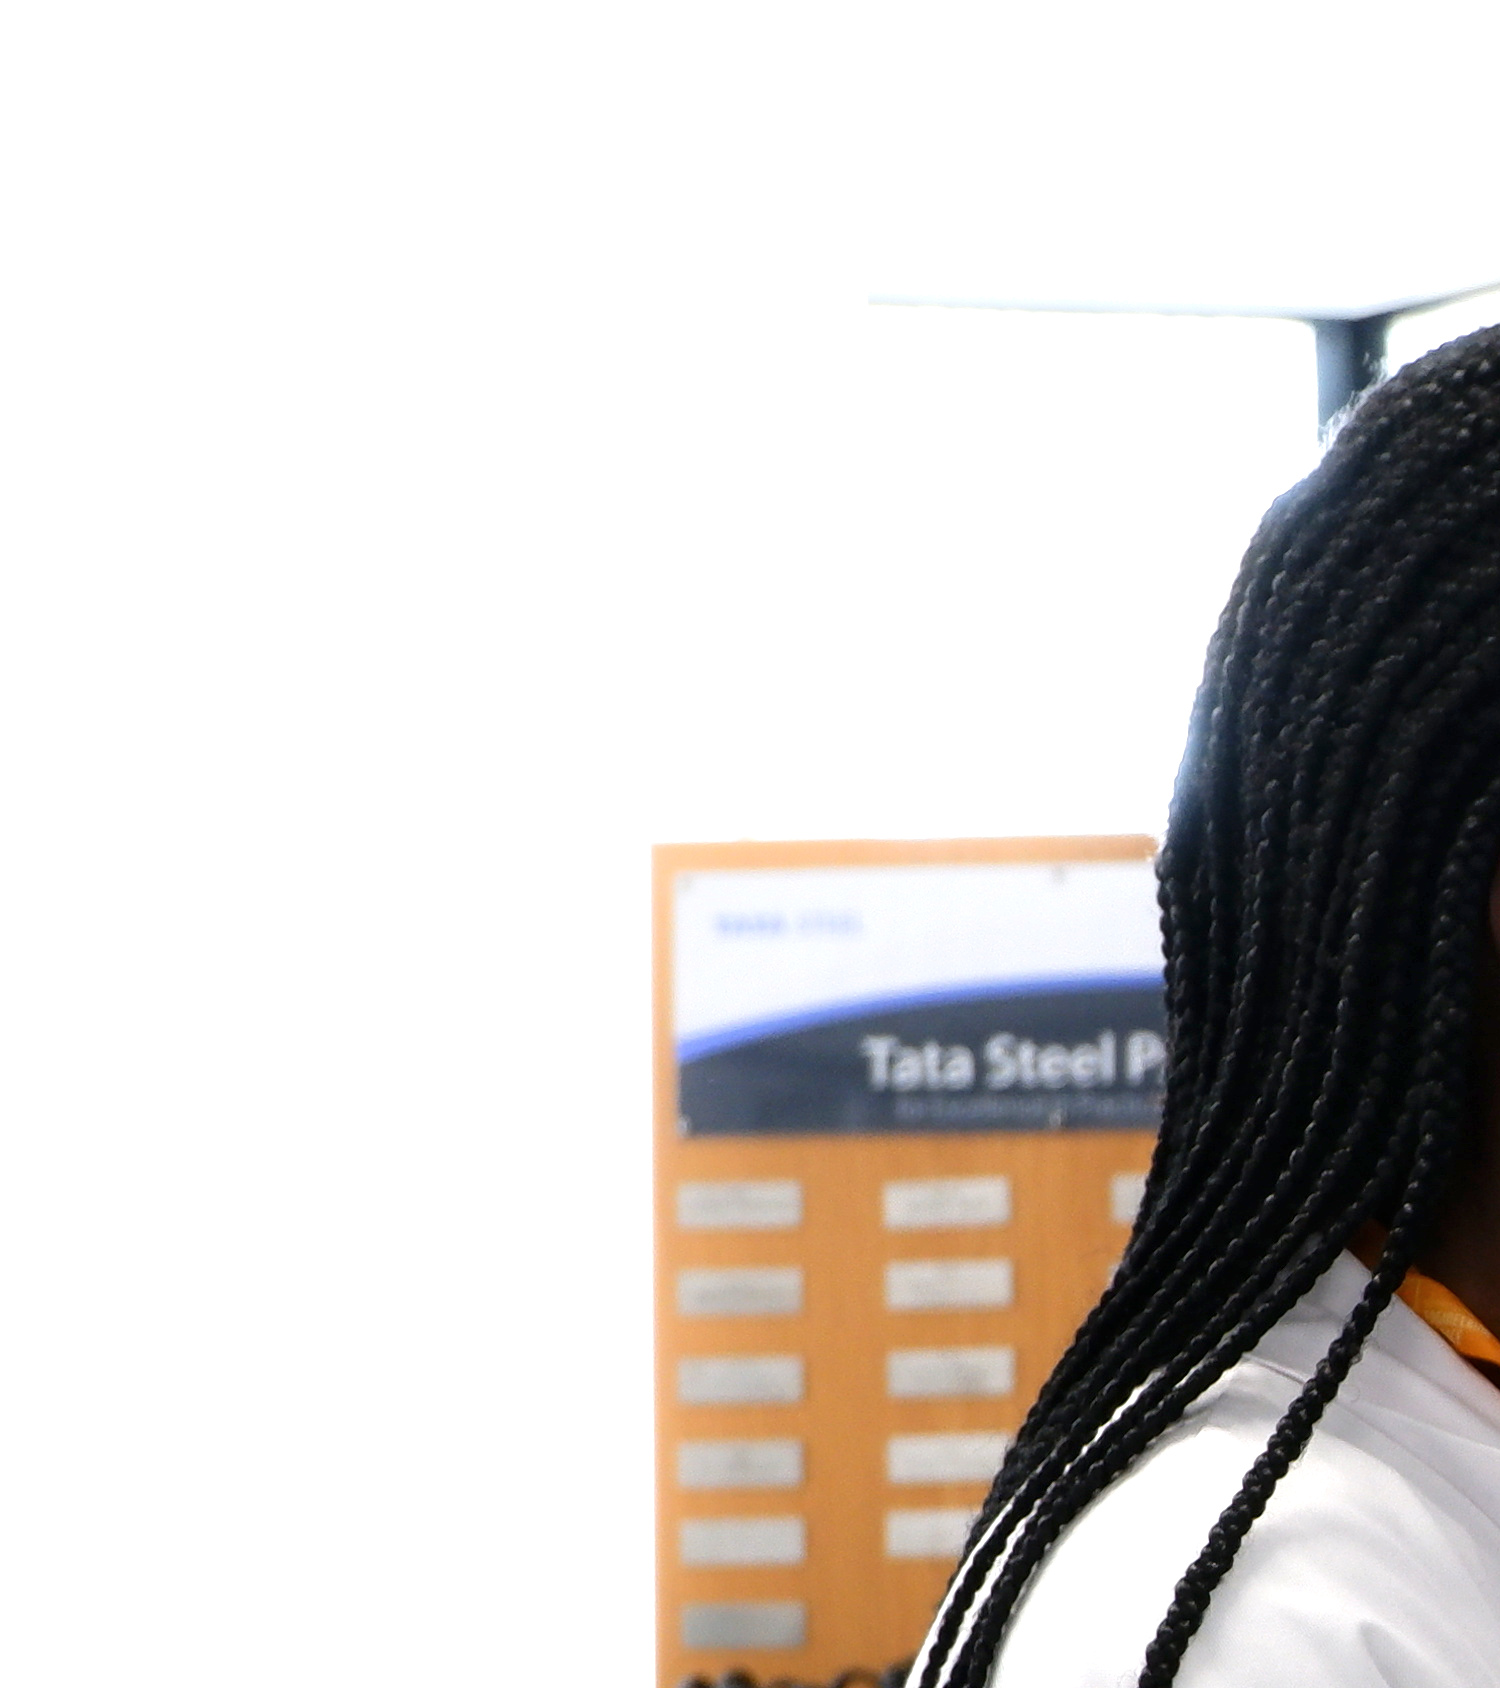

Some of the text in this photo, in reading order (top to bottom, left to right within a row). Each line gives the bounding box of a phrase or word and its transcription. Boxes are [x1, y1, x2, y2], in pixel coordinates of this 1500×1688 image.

[864, 1029, 1167, 1091] Tata Steel P
